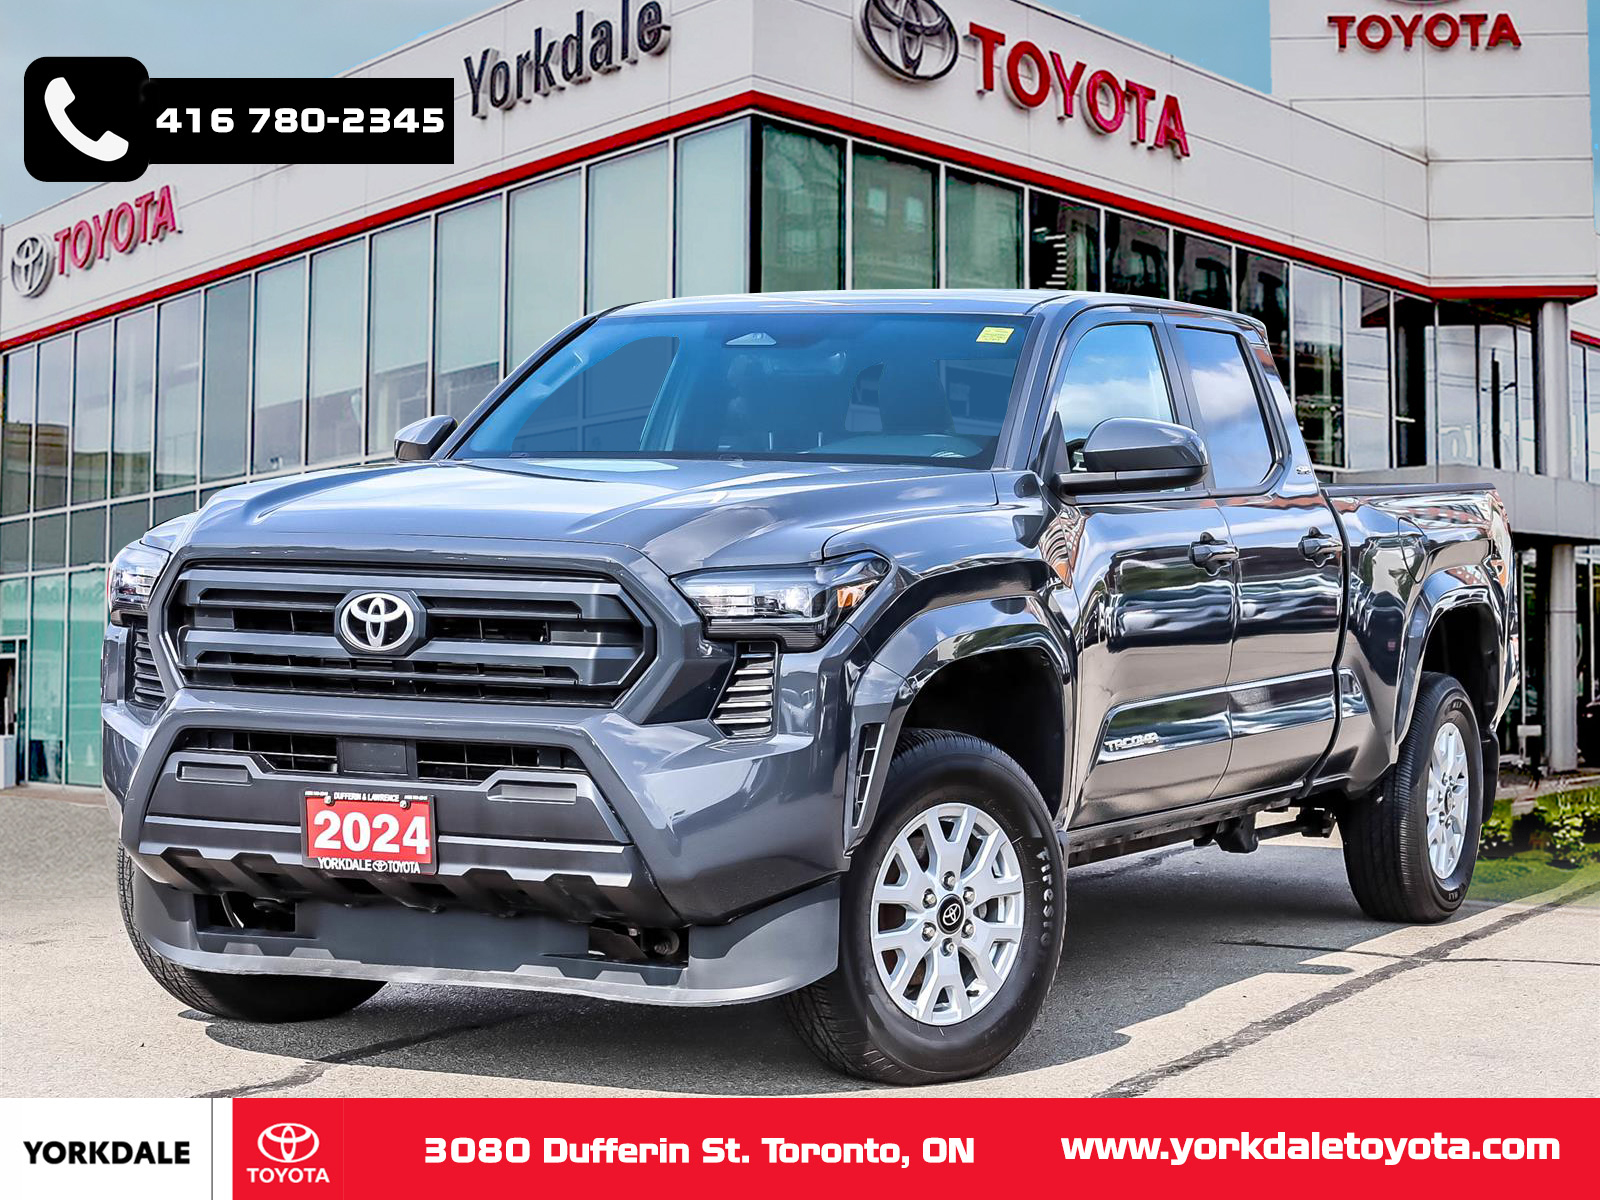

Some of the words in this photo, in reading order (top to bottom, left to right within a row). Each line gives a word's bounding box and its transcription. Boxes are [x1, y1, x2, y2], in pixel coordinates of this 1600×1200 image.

[1328, 13, 1521, 51] TOYOTA
[464, 0, 671, 119] Yorkdale
[969, 22, 1190, 158] TOYOTA
[53, 185, 180, 276] TOYOTA
[1104, 732, 1160, 752] TACOMA
[314, 810, 430, 855] 2024
[317, 857, 373, 872] YORKDALE
[387, 861, 421, 874] TOYOTA
